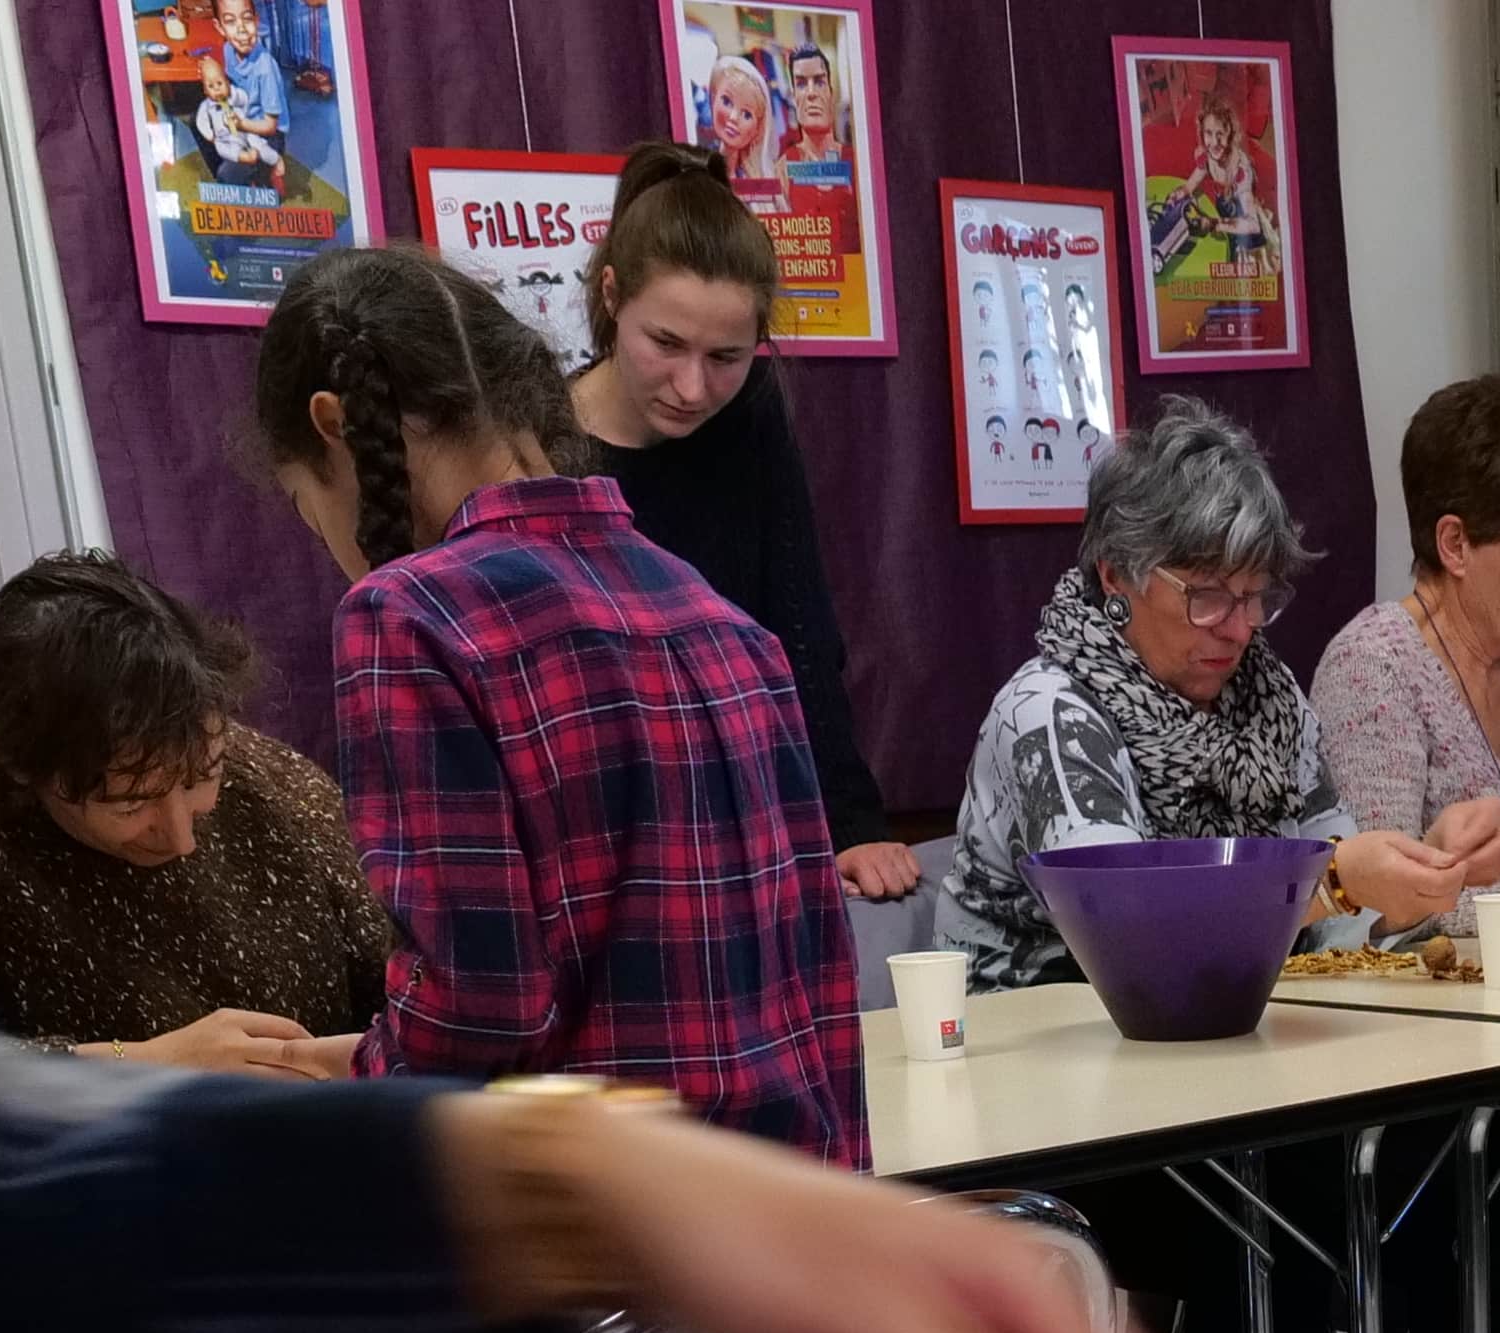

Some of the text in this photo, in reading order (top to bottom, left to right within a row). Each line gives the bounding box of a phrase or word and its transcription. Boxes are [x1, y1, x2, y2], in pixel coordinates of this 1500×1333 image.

[245, 187, 253, 204] 6
[254, 187, 276, 206] ANS
[235, 209, 273, 232] PAPA
[276, 211, 323, 235] POULE
[781, 213, 832, 236] MODÈLES
[961, 222, 1062, 262] GARÇONS
[784, 259, 829, 278] ENFANTS
